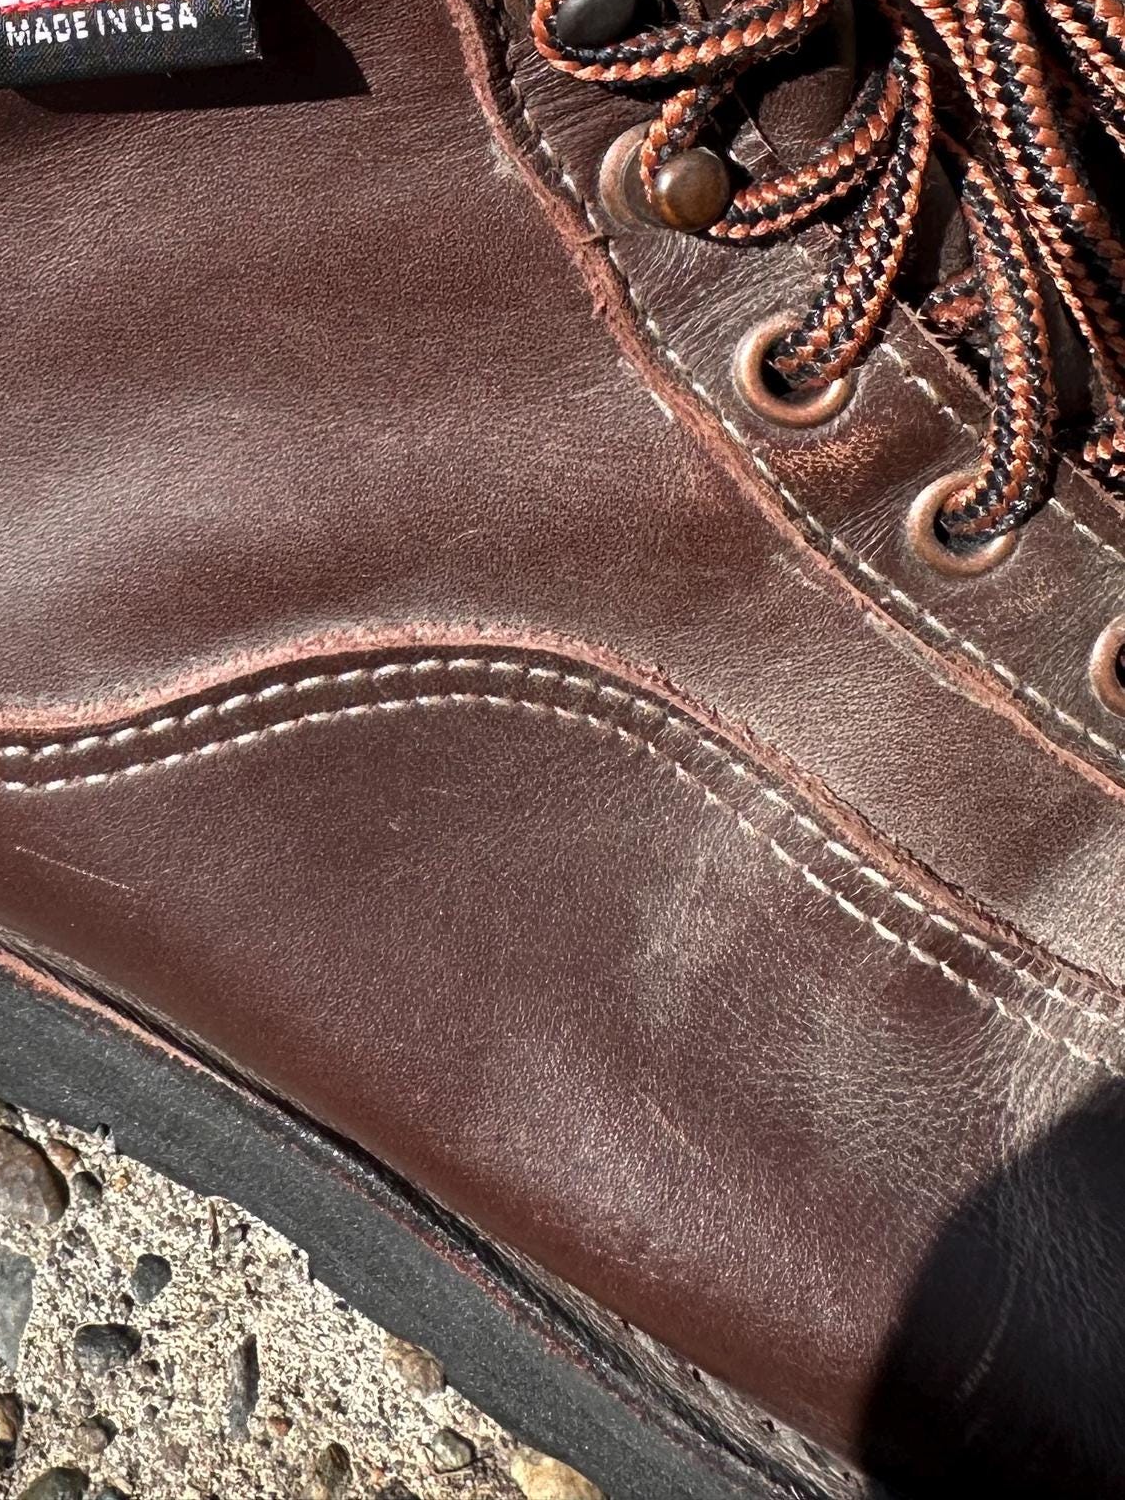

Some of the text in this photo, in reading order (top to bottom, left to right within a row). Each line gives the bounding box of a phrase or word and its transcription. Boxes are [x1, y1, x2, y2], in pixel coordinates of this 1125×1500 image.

[5, 2, 198, 47] MADE IN USA
